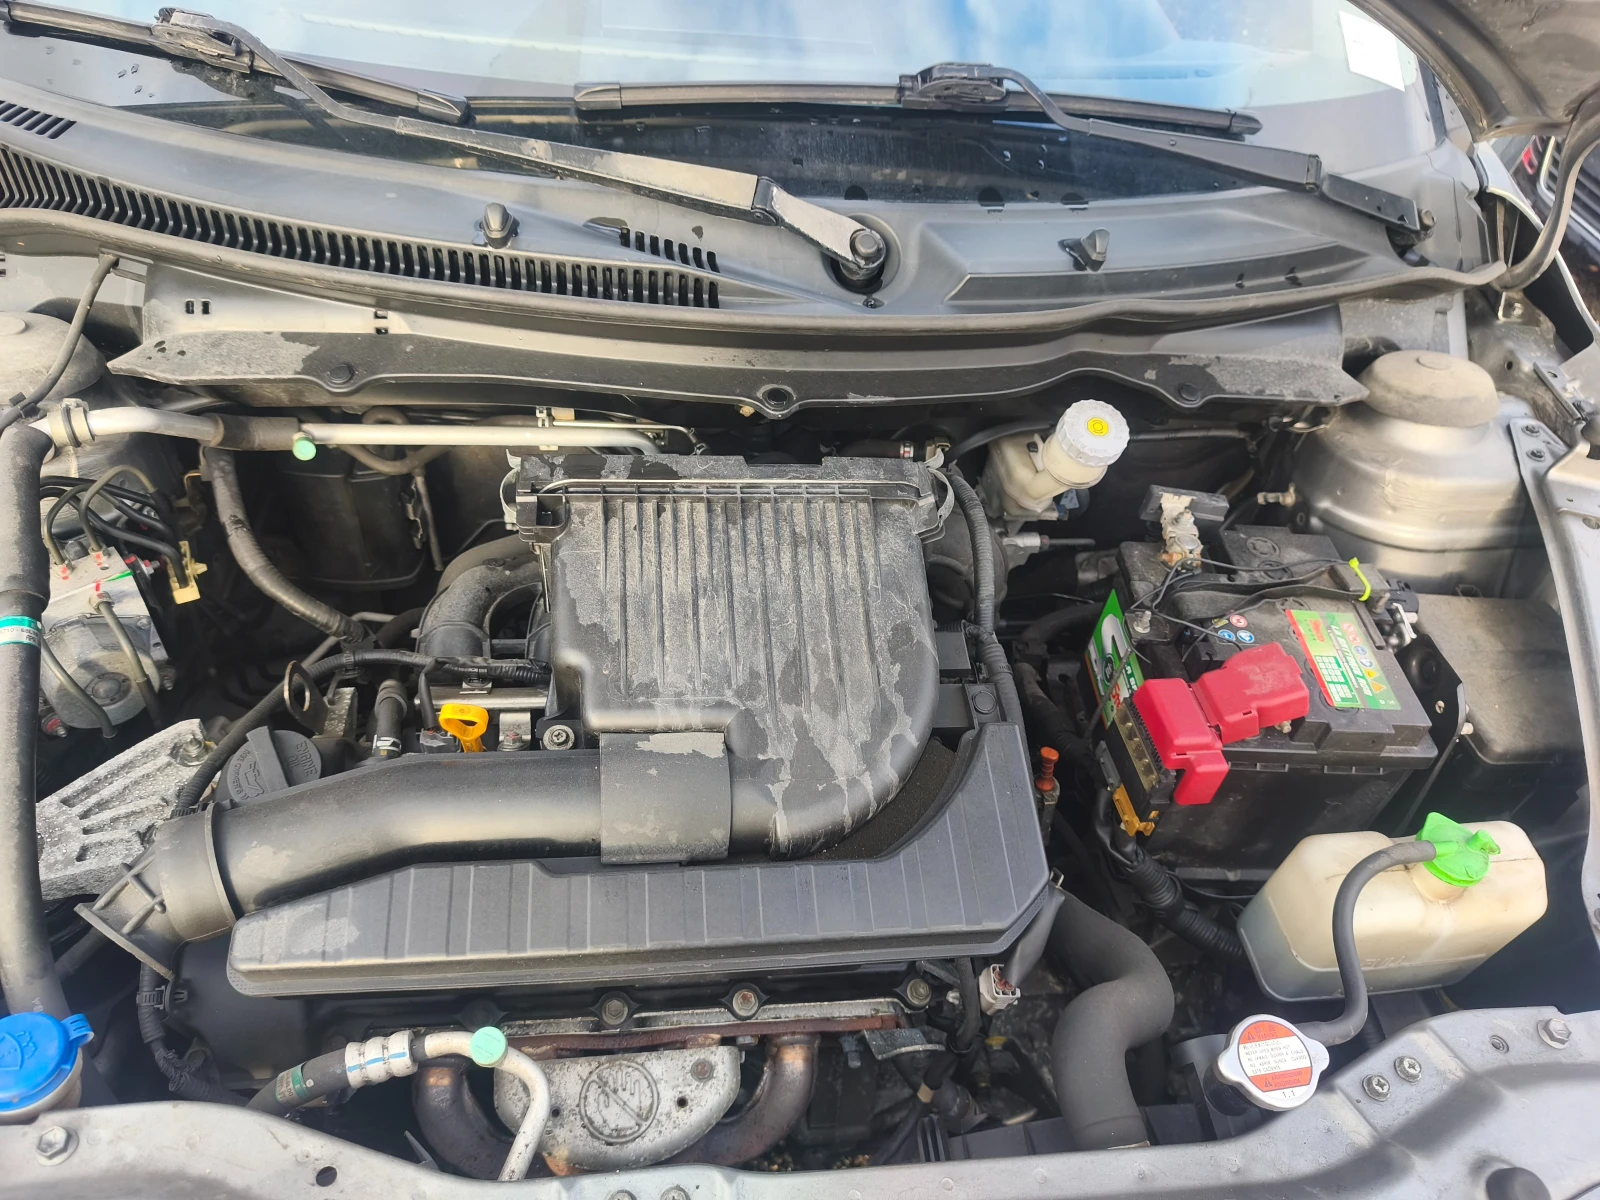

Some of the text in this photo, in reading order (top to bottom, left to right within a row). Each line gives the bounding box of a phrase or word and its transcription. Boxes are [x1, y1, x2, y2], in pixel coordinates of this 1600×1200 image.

[287, 755, 300, 768] OIL
[296, 740, 318, 777] ENGINE
[1282, 1090, 1295, 1098] 1.1
